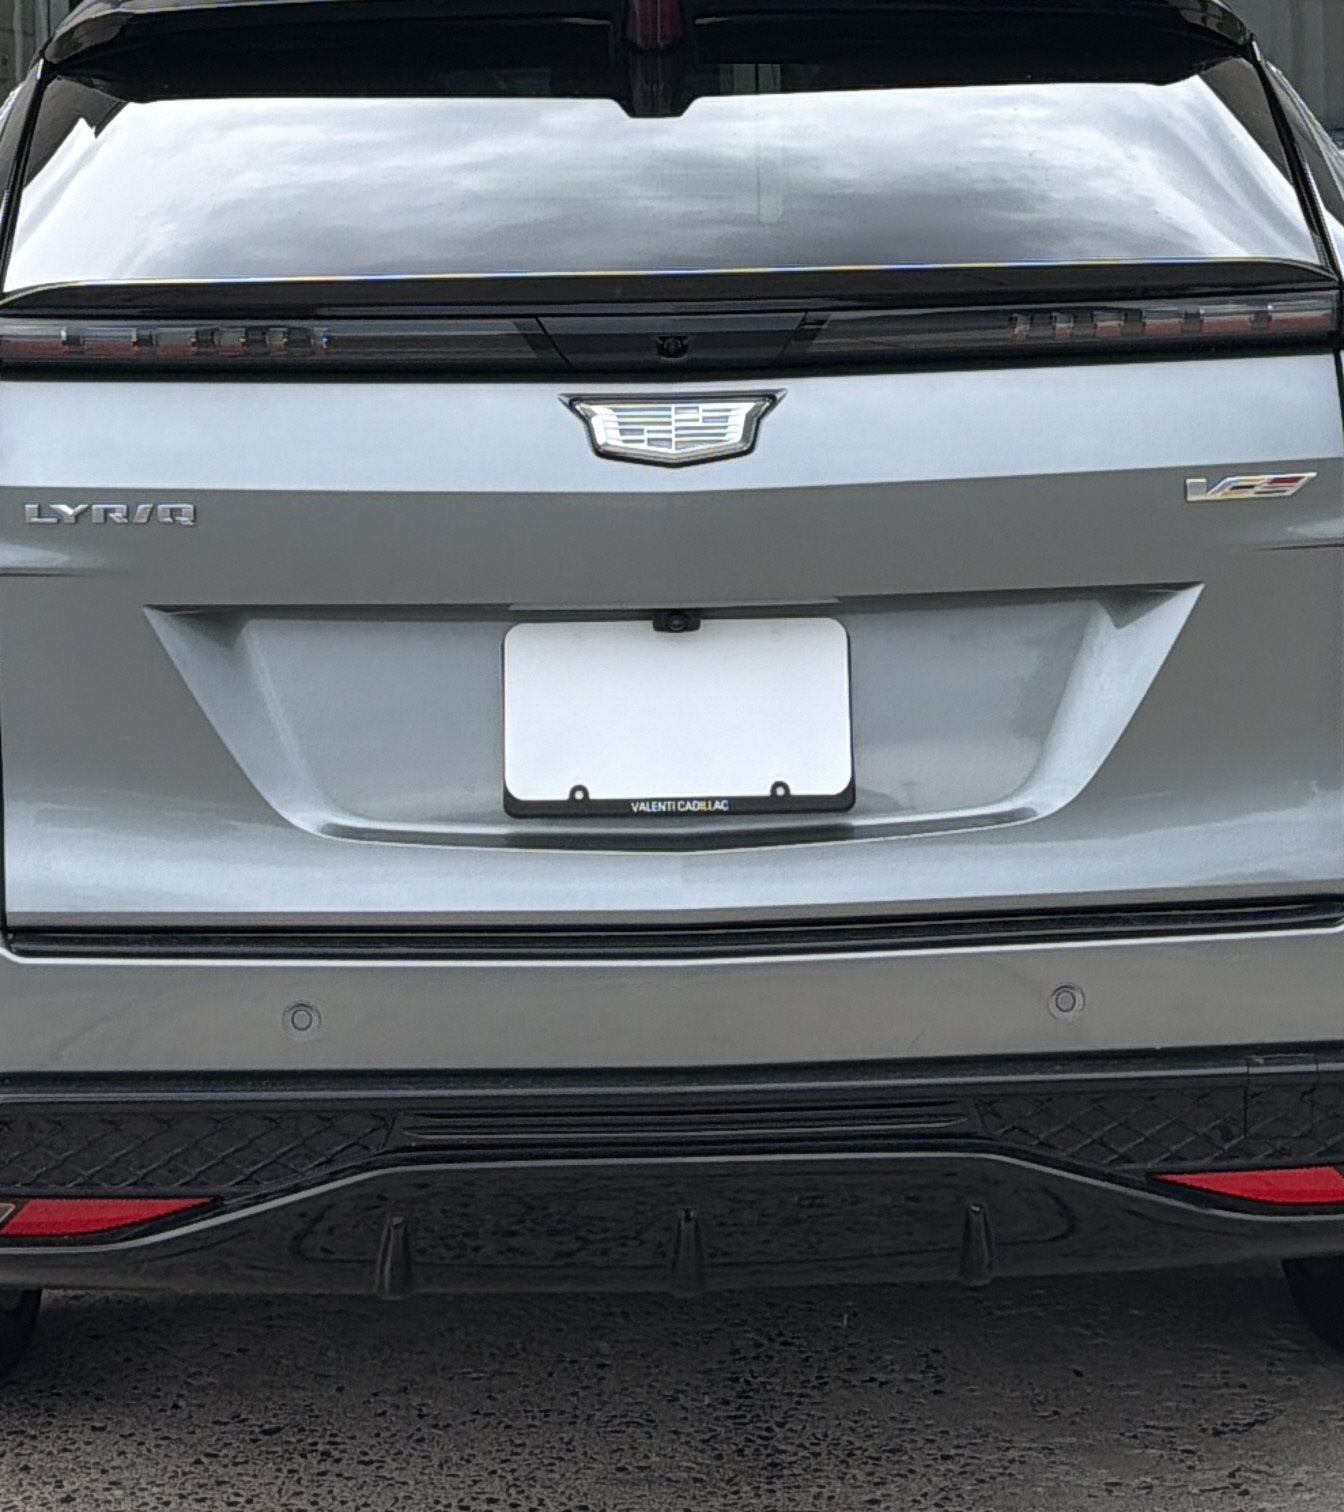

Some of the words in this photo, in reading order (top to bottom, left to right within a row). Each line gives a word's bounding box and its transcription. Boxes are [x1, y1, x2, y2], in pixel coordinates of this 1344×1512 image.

[23, 502, 198, 526] LYRIQ
[630, 800, 676, 813] VALENTI
[677, 799, 730, 812] CADILLAC
